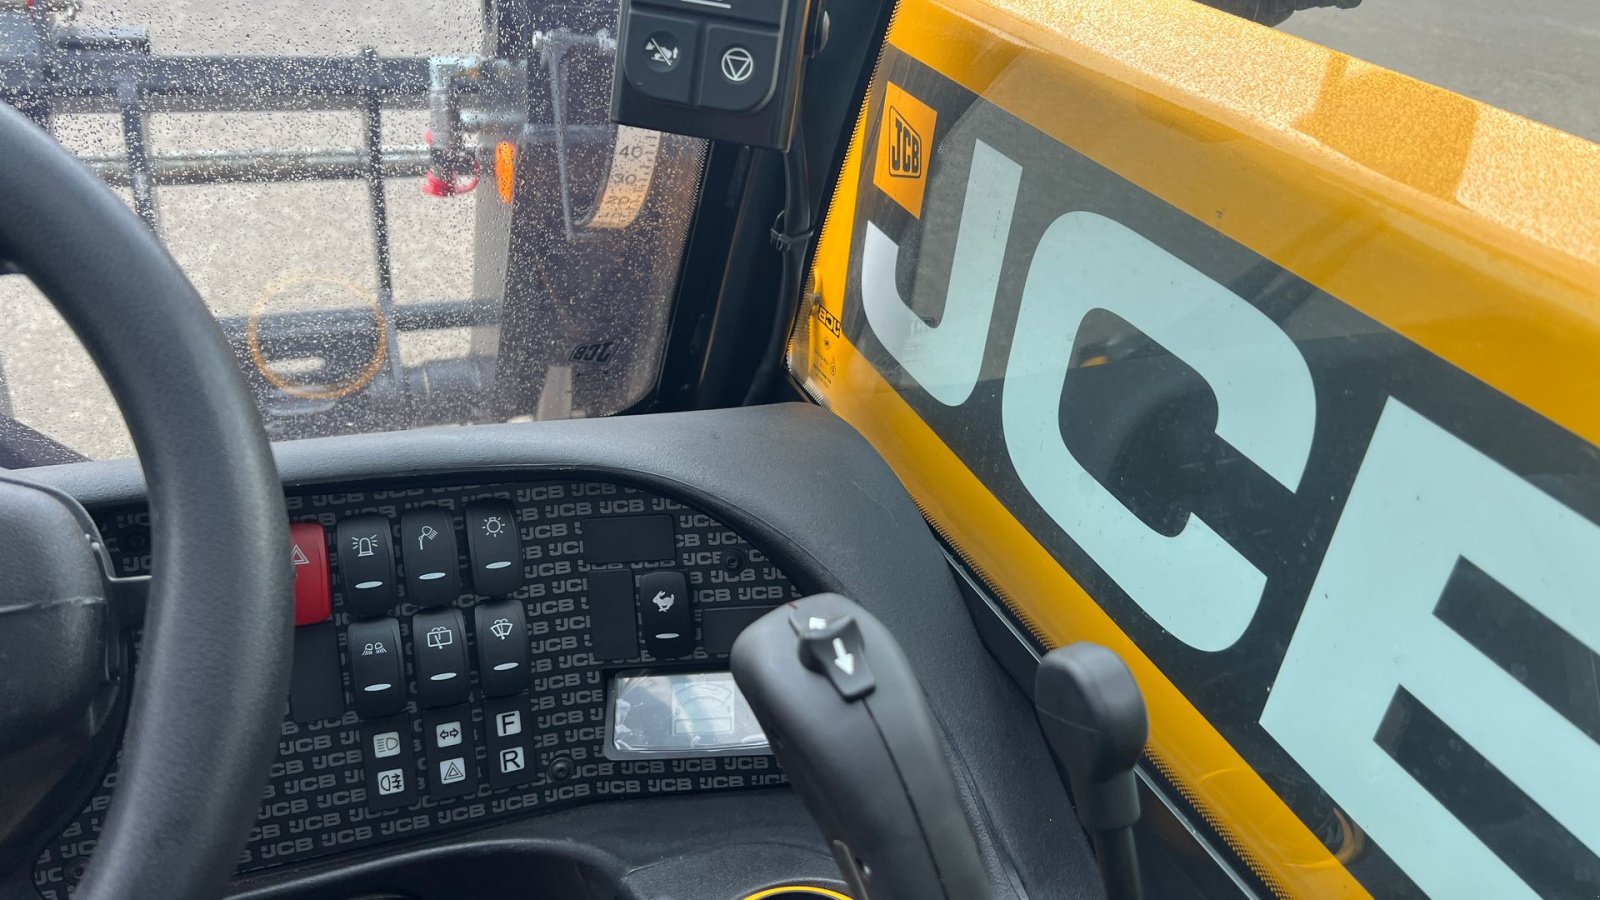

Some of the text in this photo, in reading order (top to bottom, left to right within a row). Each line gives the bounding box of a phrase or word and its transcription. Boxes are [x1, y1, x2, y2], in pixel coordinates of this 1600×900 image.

[619, 145, 643, 158] 40
[891, 117, 920, 173] JCB
[517, 485, 565, 502] JCB
[571, 483, 617, 497] JCB
[545, 502, 592, 518] JCB
[600, 499, 645, 514] JCB
[652, 498, 690, 511] JC
[521, 523, 568, 540] JCB
[708, 531, 747, 546] JC
[524, 561, 571, 578] JCB
[527, 598, 575, 616] JCB
[738, 586, 783, 600] JCB
[531, 636, 578, 654] JCB
[534, 672, 581, 691] JCB
[502, 713, 516, 734] F
[538, 710, 584, 729] JCB
[279, 735, 332, 755] JCB
[269, 749, 363, 777] CB JCB
[502, 750, 520, 771] R
[620, 761, 665, 774] JCB
[672, 758, 717, 772] JCB
[724, 757, 769, 770] JCB
[284, 773, 336, 794] JCB
[256, 787, 367, 820] JCB JCB
[261, 837, 314, 858] JCB
[321, 826, 373, 847] JCB
[380, 815, 430, 835] JCB
[437, 804, 485, 823] JCB
[492, 794, 538, 813] JCB
[544, 783, 590, 802] JCB
[597, 780, 641, 794] JCB
[648, 778, 692, 792] JCB
[700, 776, 744, 789] JCB
[289, 812, 341, 833] JCB
